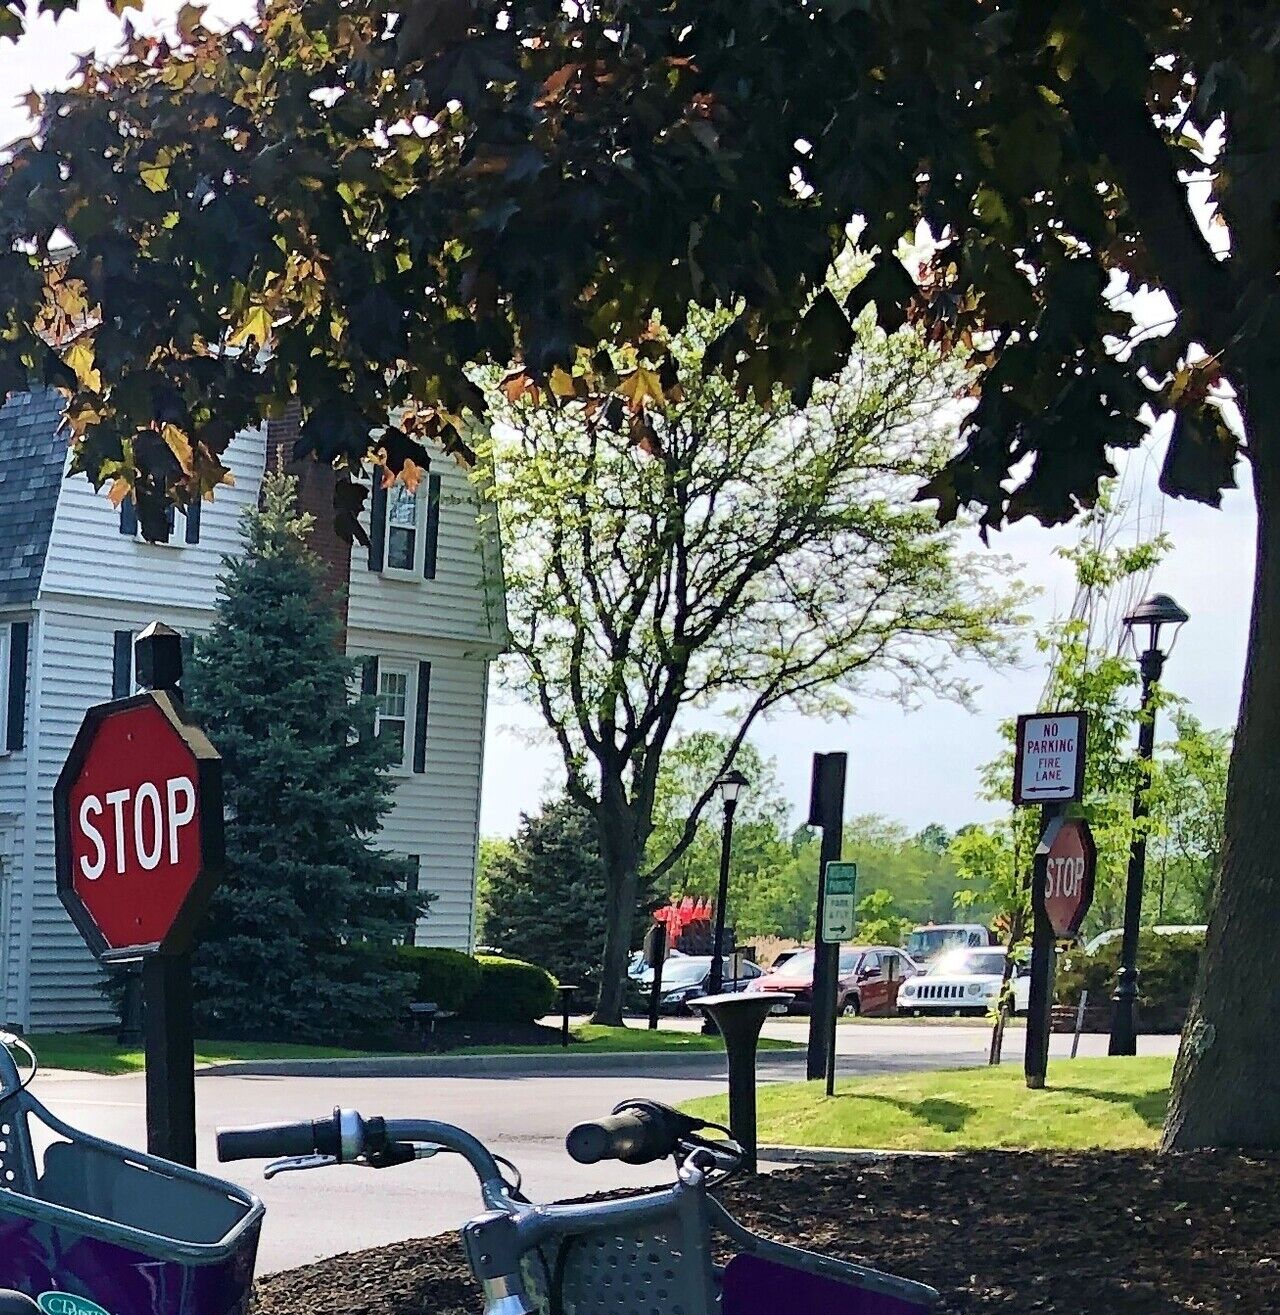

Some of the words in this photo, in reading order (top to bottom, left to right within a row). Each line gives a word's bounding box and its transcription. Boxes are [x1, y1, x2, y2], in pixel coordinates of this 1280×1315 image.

[1043, 723, 1058, 737] NO
[1027, 739, 1074, 754] PARKING
[1038, 757, 1061, 769] FIRE
[1035, 769, 1062, 782] LANE
[78, 775, 195, 881] STOP
[1044, 856, 1085, 899] STOP
